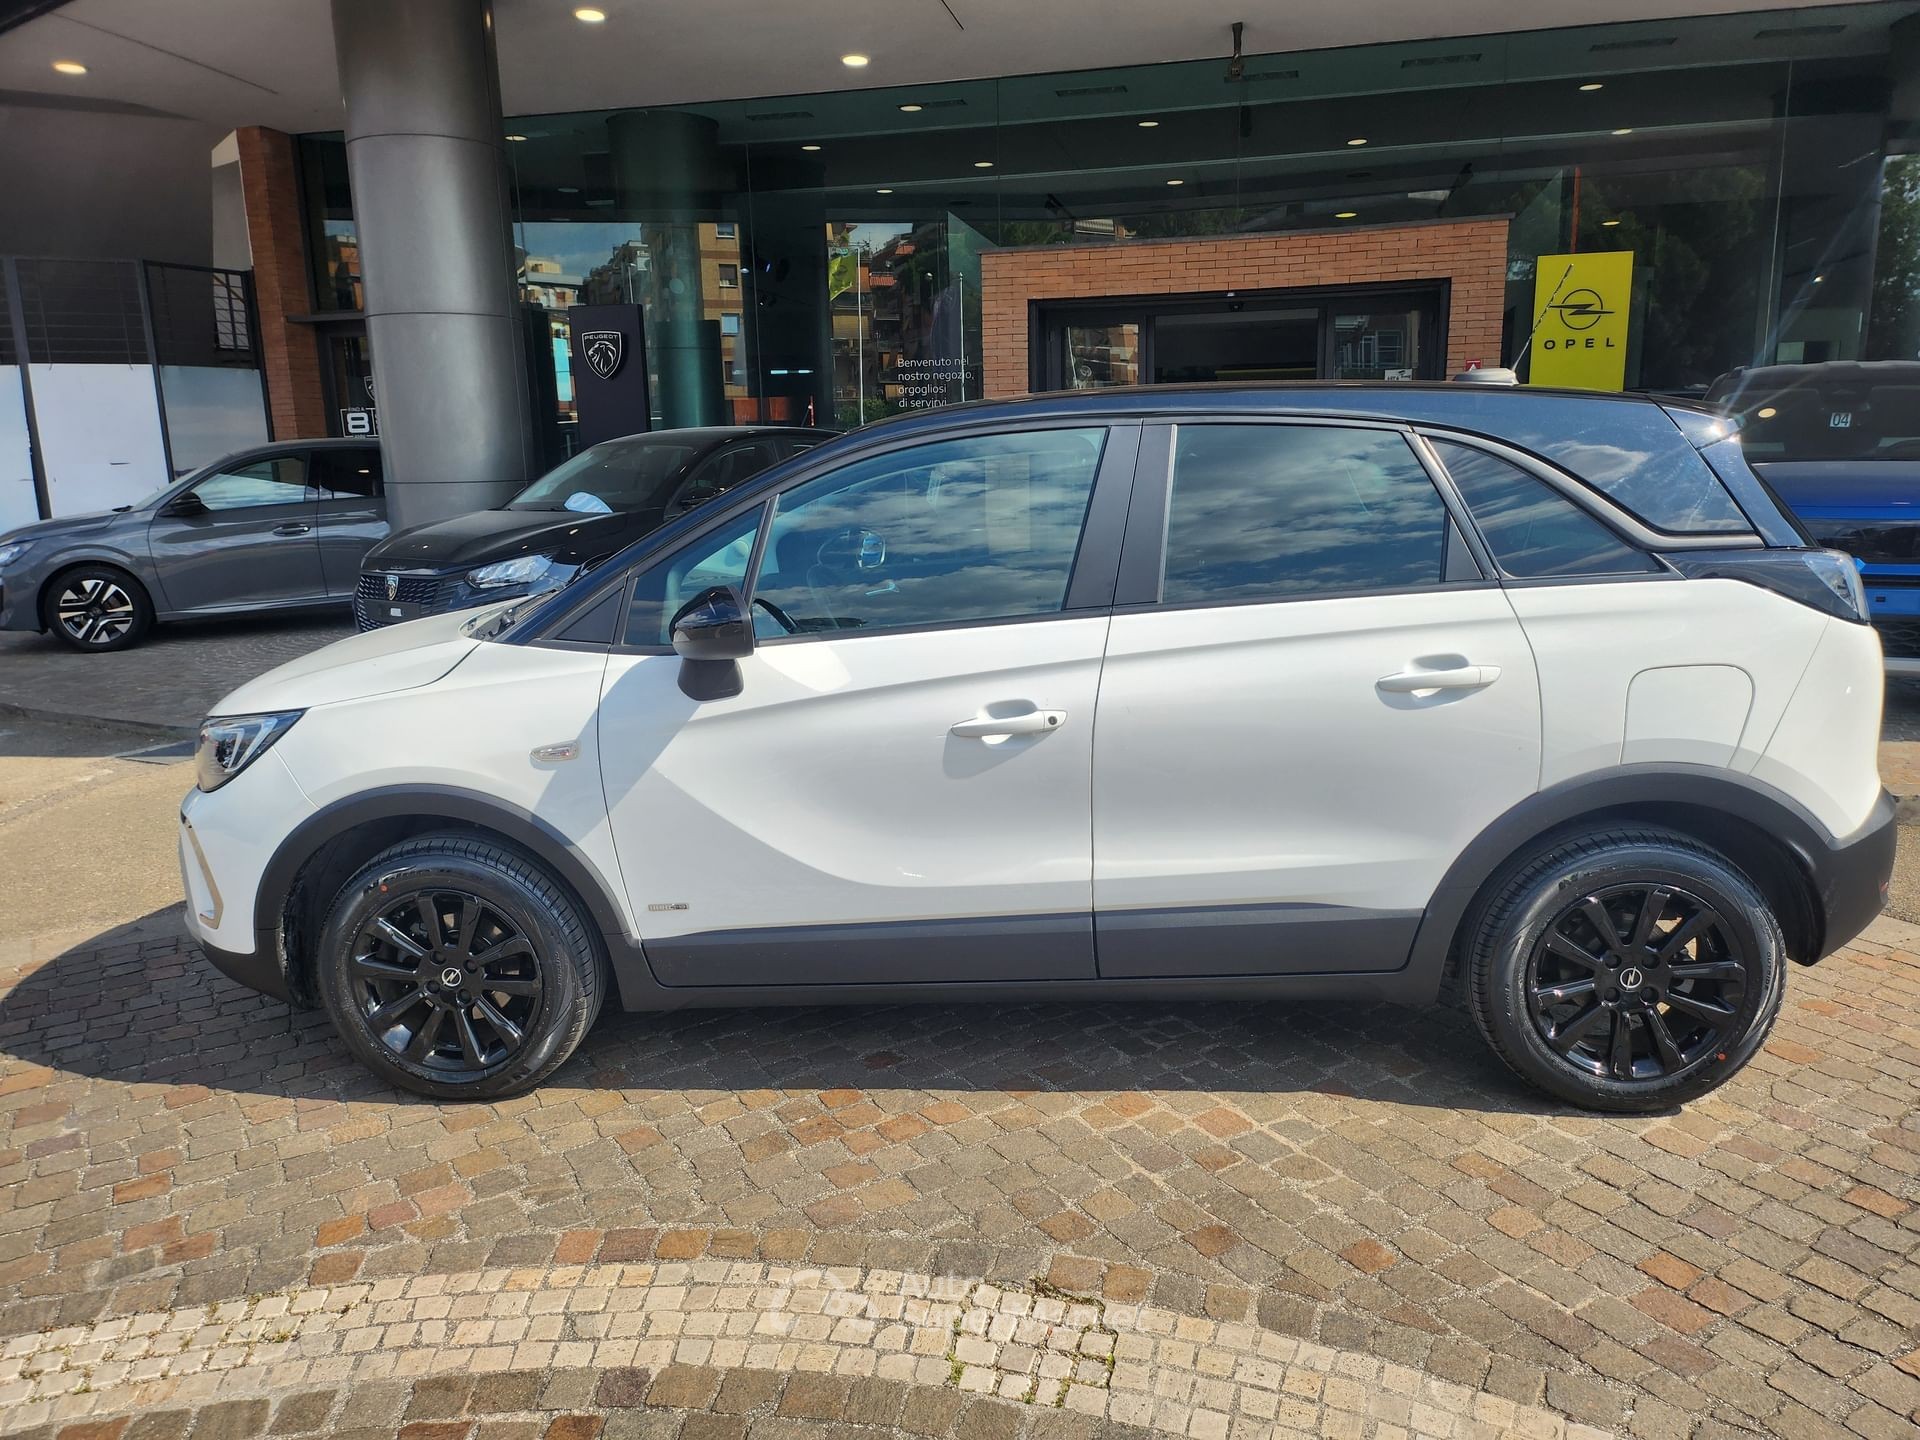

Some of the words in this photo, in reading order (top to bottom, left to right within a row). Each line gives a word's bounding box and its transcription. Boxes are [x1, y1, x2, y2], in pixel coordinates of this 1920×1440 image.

[1543, 336, 1616, 351] OPEL
[897, 357, 952, 368] Benvenuto
[954, 355, 969, 366] nel
[897, 371, 931, 381] nostro
[932, 370, 975, 382] negozo,
[898, 383, 947, 396] orgogliosi
[898, 397, 908, 408] di
[346, 412, 370, 434] 8
[1832, 413, 1849, 427] 04
